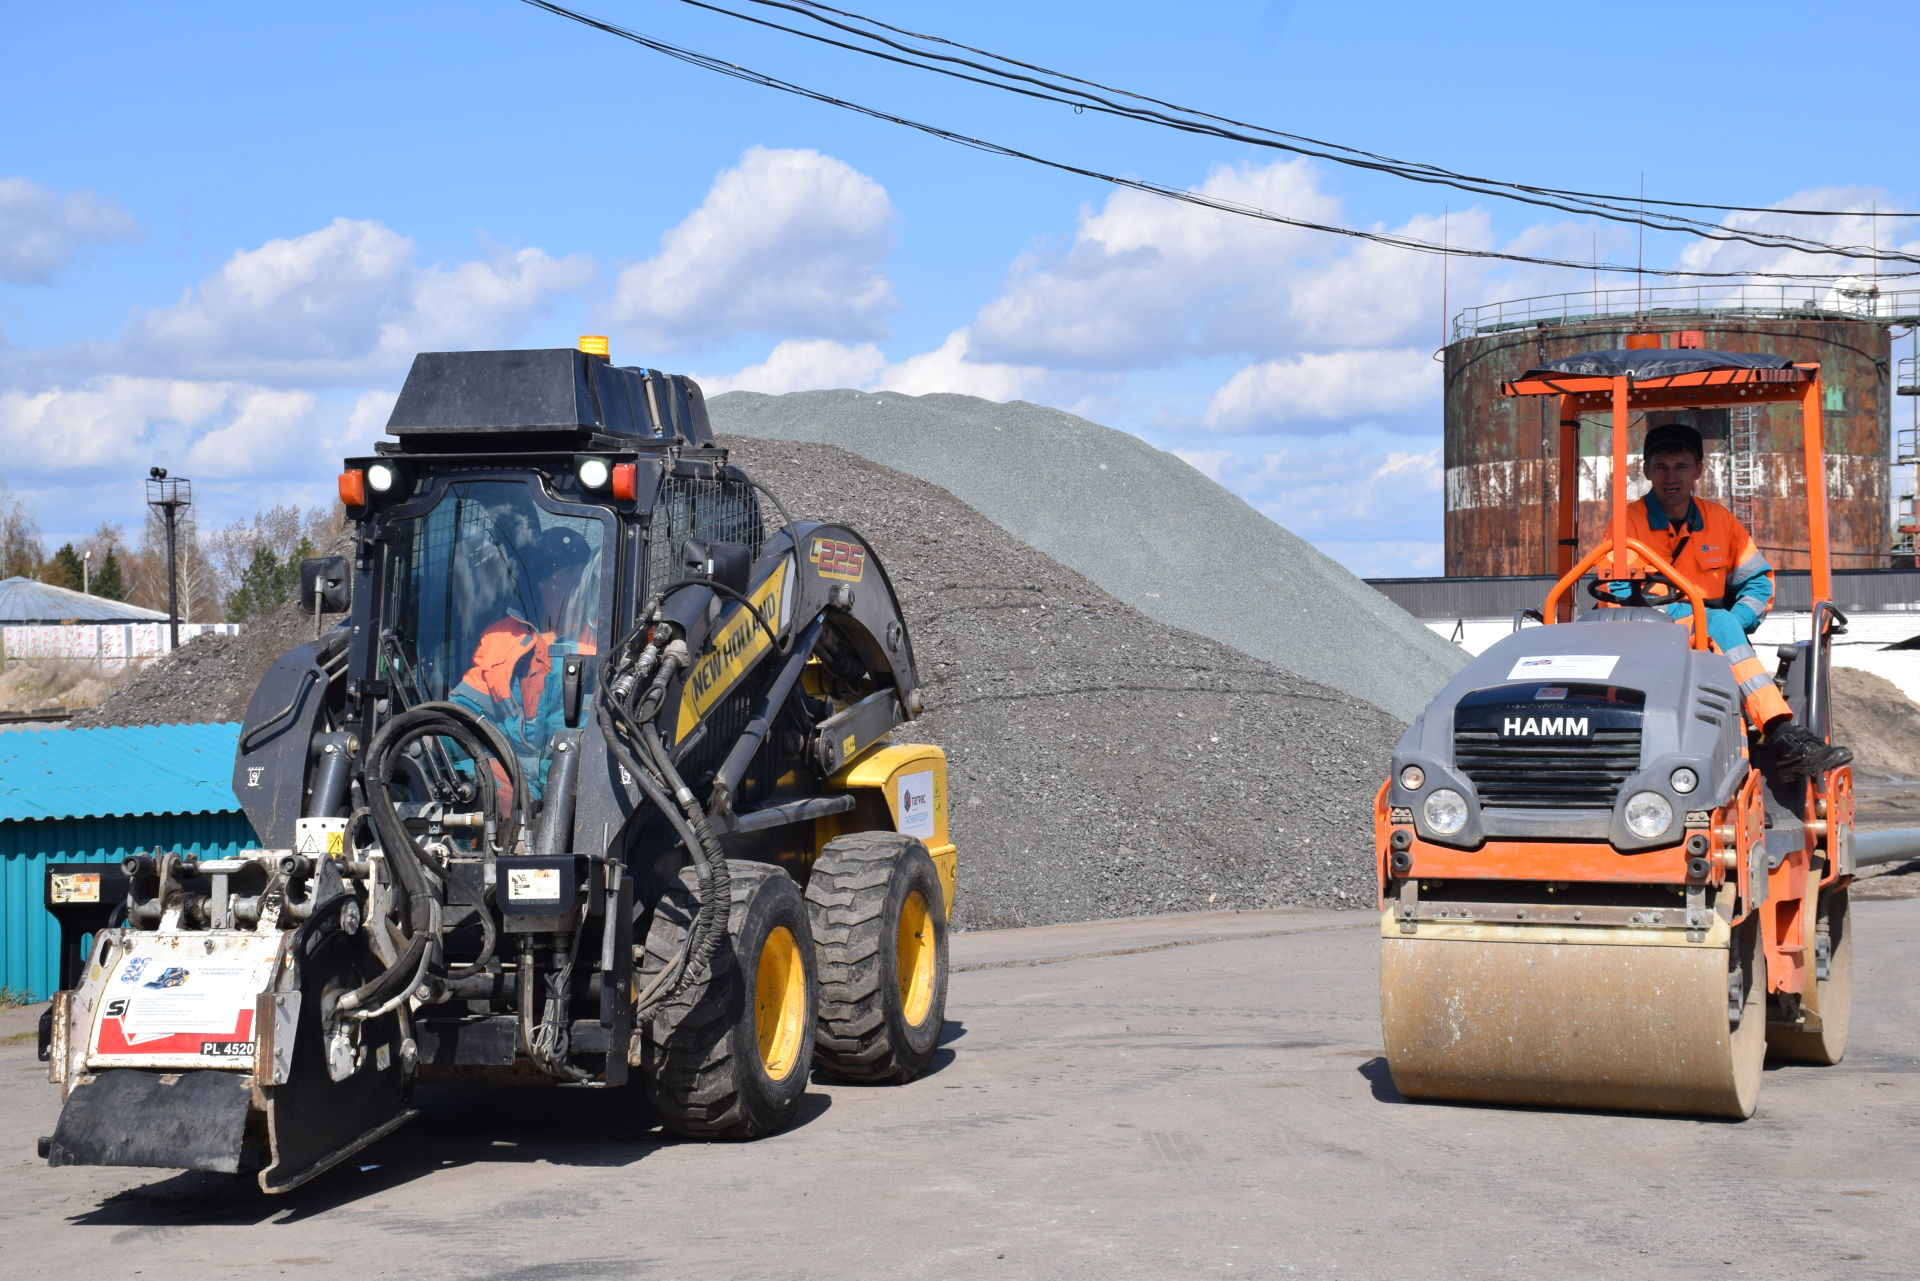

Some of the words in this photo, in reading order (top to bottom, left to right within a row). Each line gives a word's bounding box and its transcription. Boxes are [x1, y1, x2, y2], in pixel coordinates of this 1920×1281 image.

[692, 650, 722, 701] NEW
[1503, 717, 1589, 736] HAMM
[203, 1043, 221, 1055] PL
[224, 1042, 255, 1055] 4520
